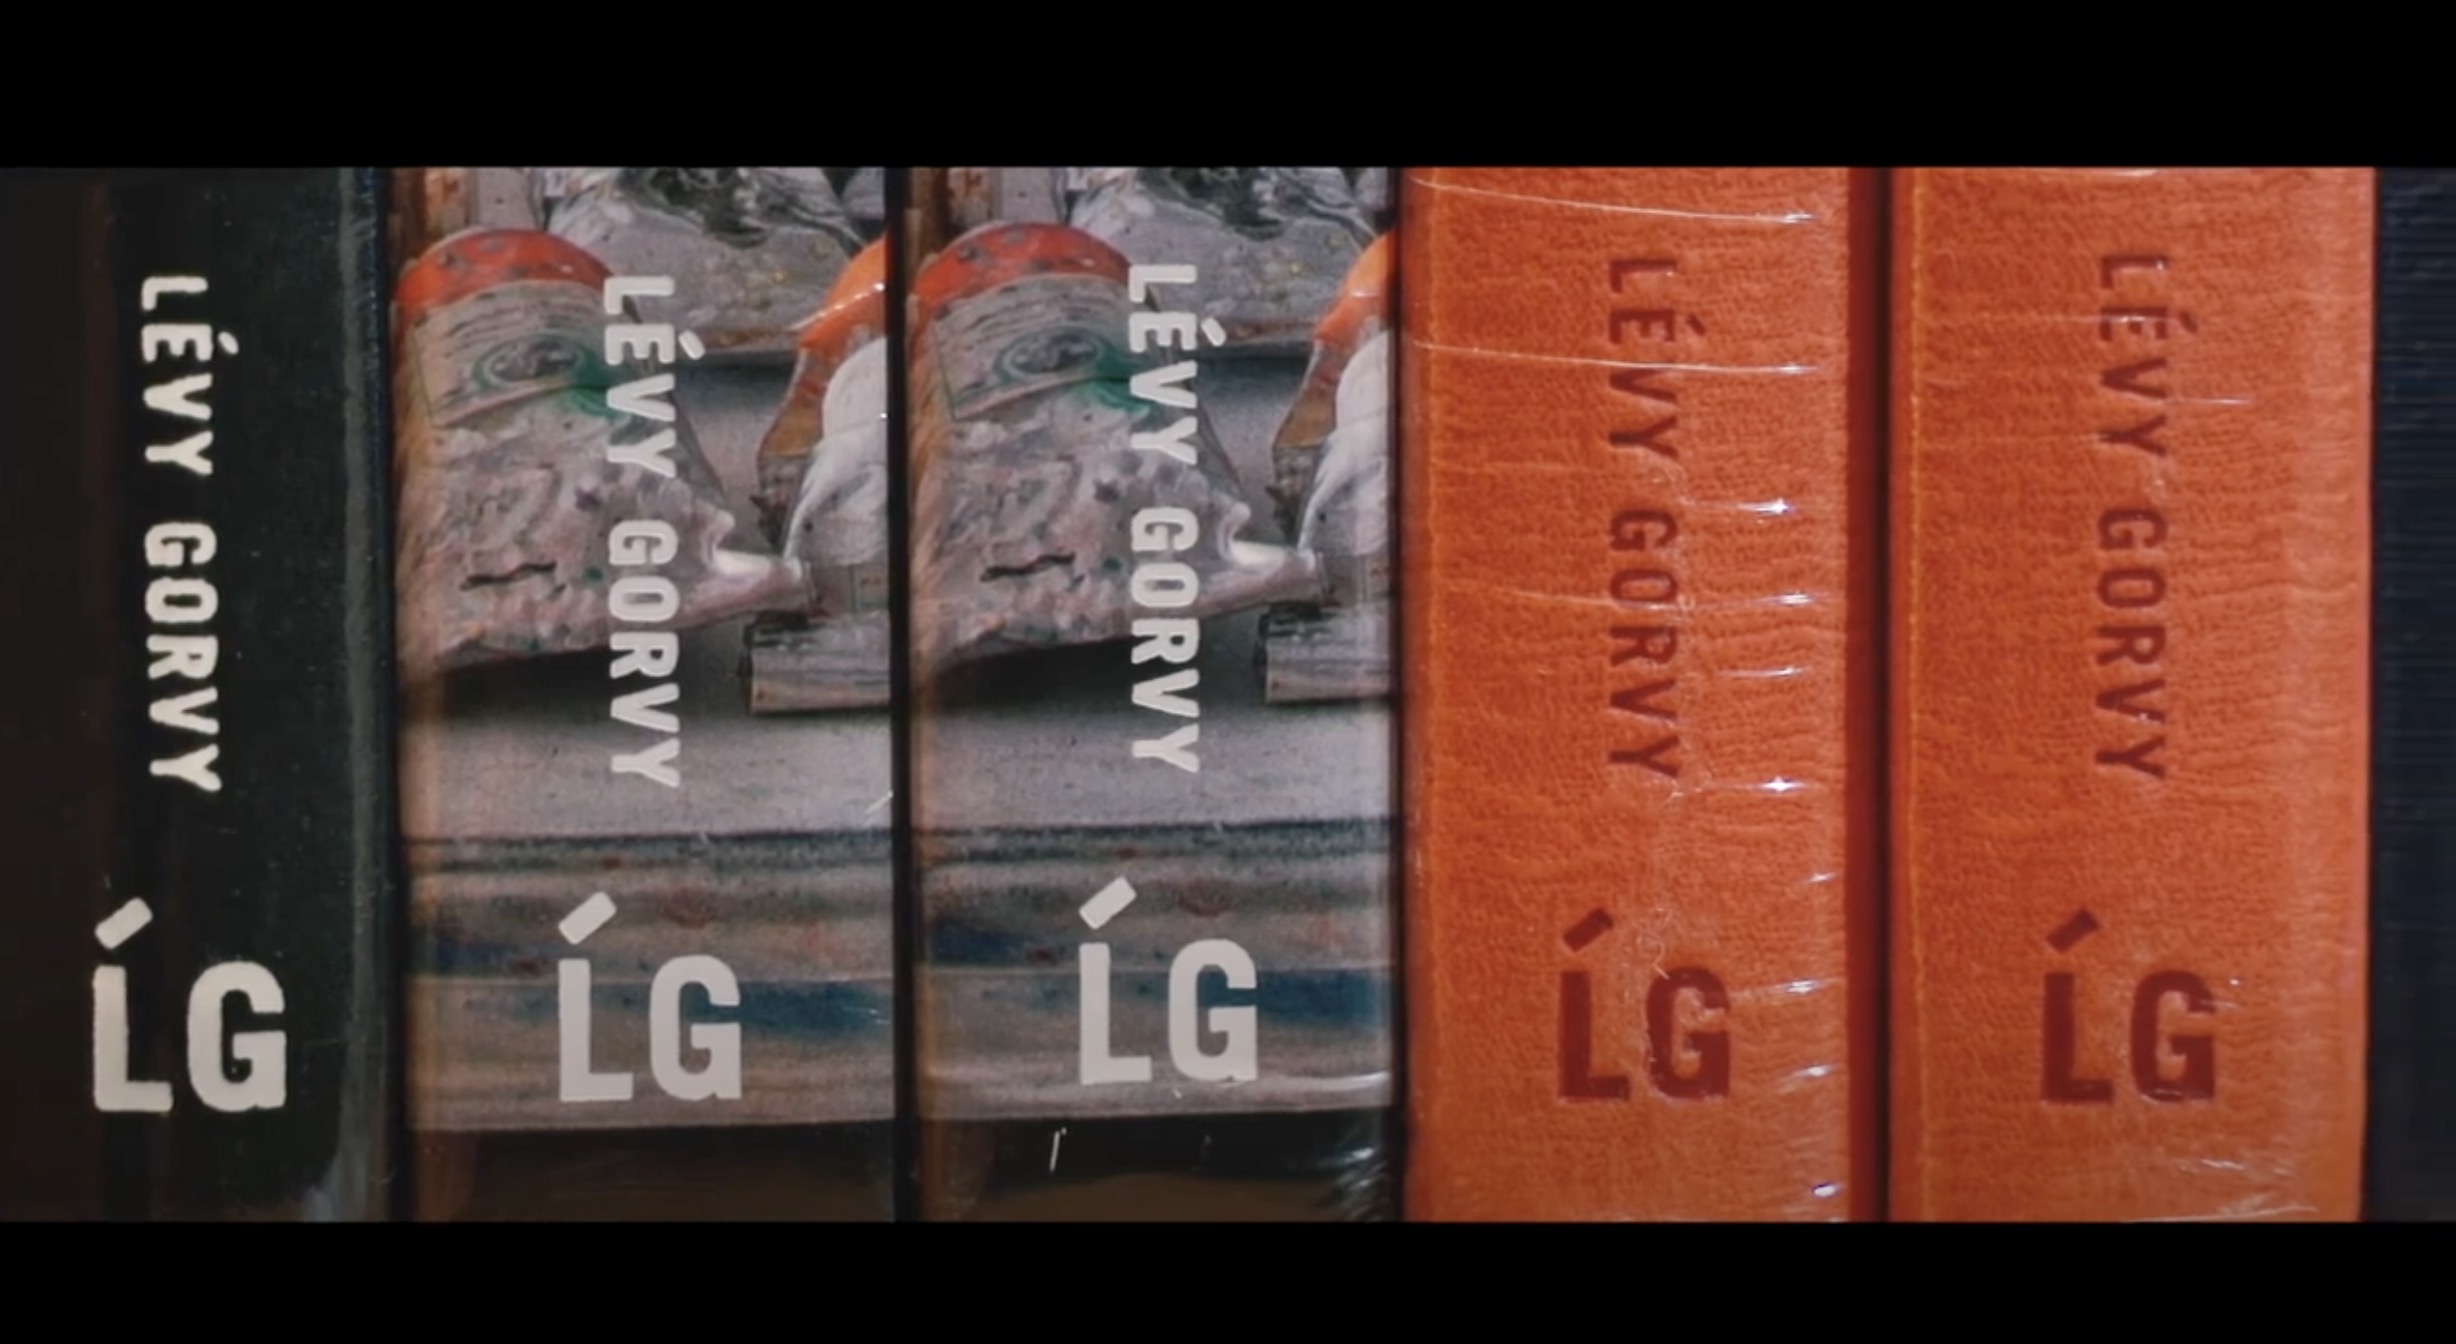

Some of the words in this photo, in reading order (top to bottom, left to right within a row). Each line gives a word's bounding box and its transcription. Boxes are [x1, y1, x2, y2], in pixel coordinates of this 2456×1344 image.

[141, 276, 239, 475] LÉVY
[604, 275, 706, 479] LÉVY
[1128, 264, 1227, 466] LÉVY
[1608, 256, 1706, 462] LÉVY
[2098, 253, 2199, 459] LÉVY
[144, 521, 222, 793] GORVY
[608, 520, 680, 787] GORVY
[1130, 506, 1200, 774] GORVY
[1608, 508, 1679, 779] GORVY
[2095, 507, 2168, 779] GORVY
